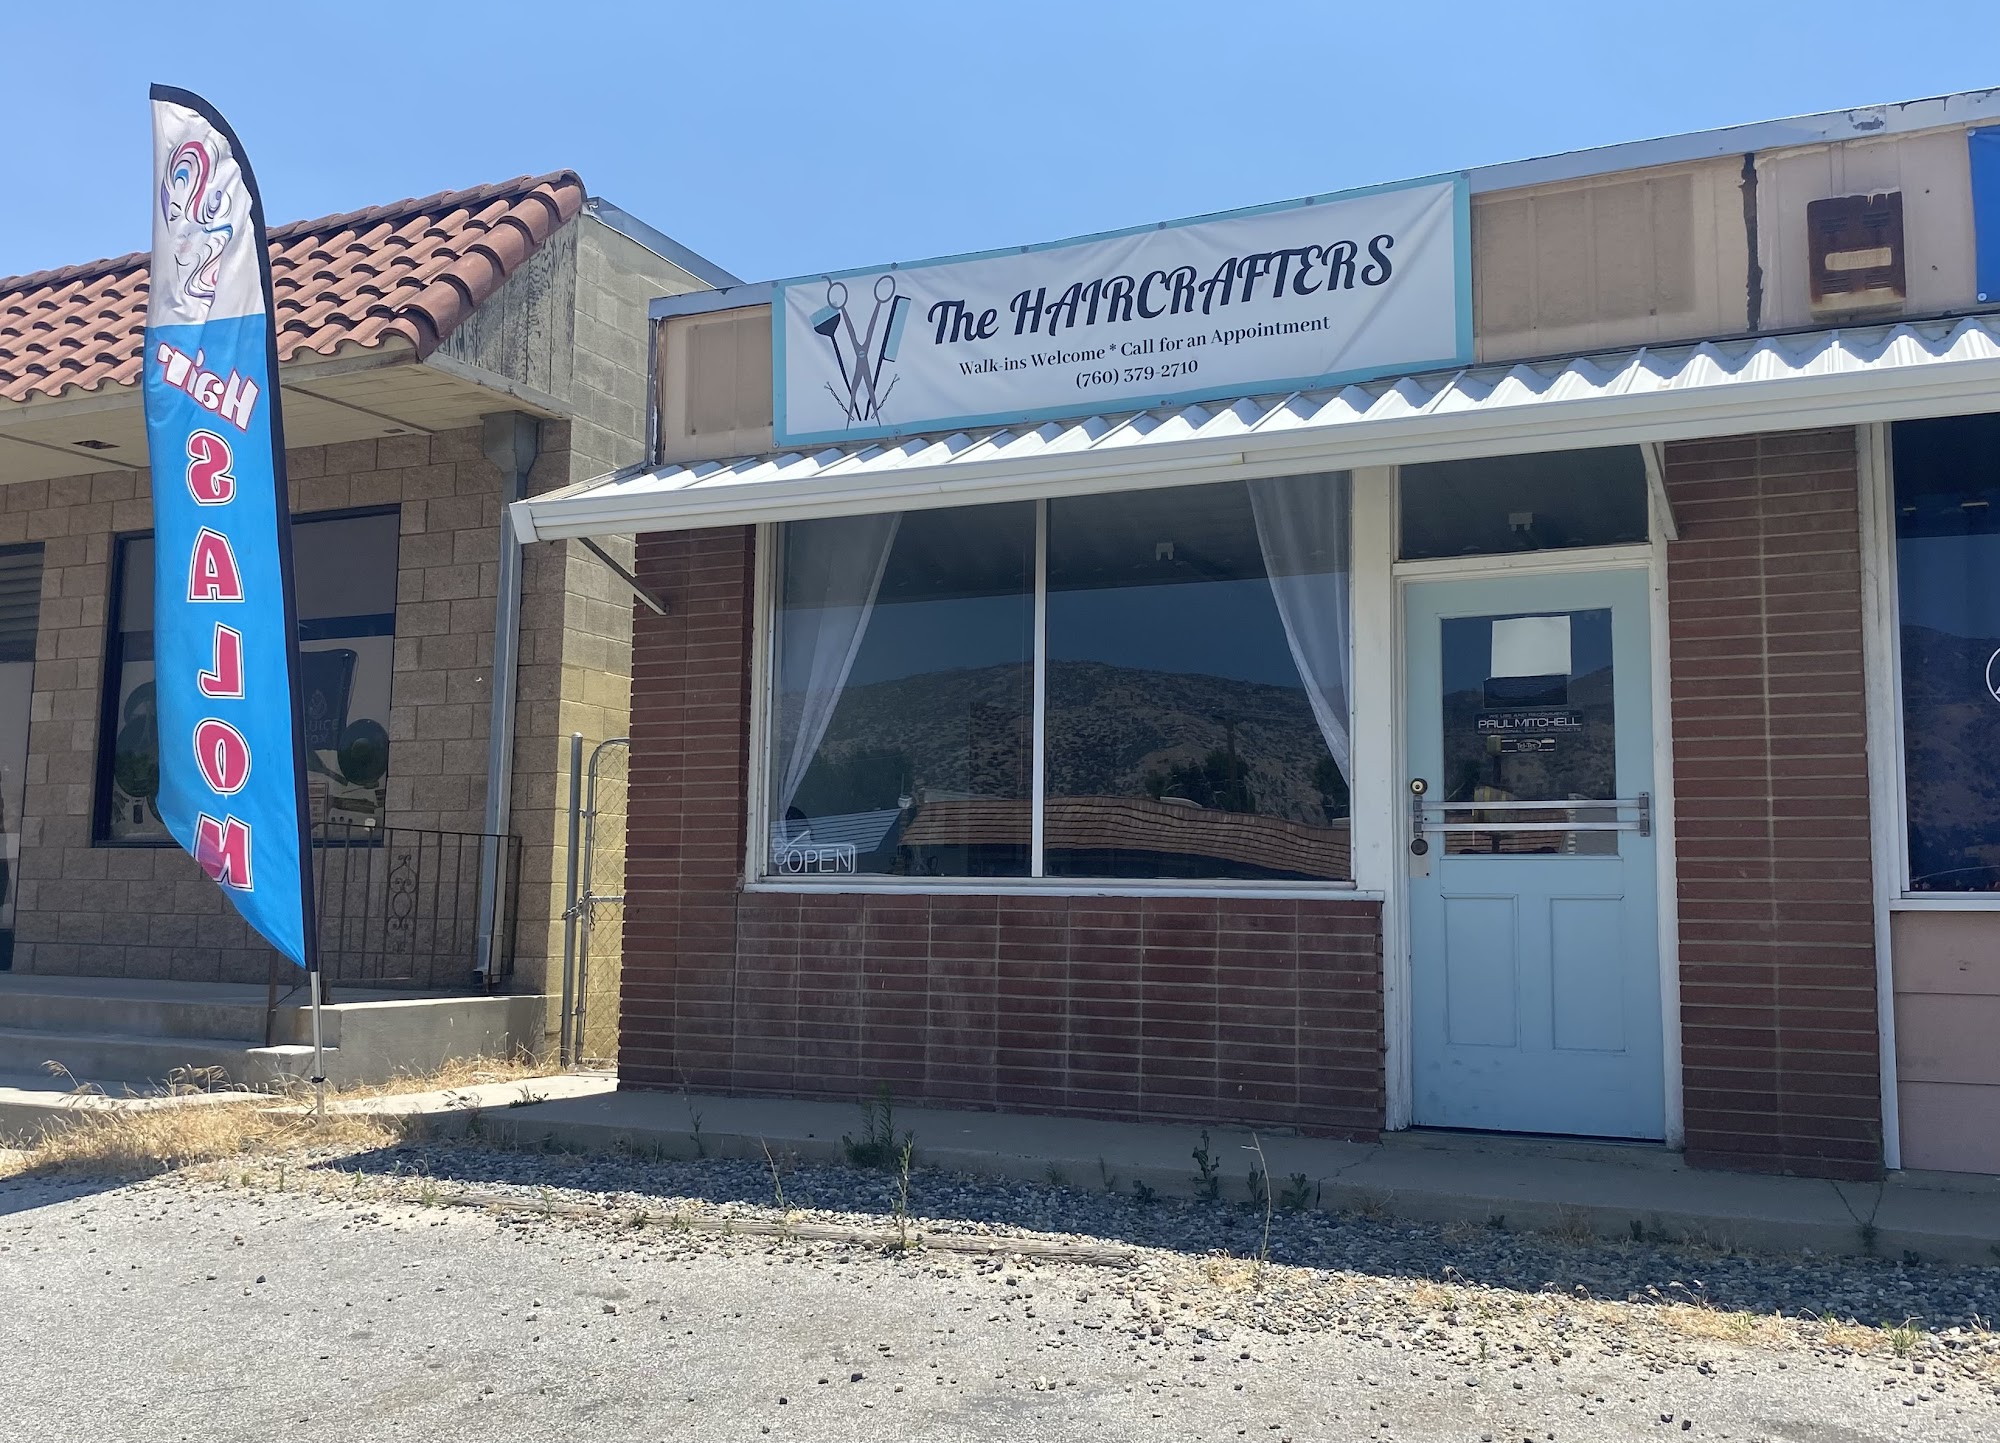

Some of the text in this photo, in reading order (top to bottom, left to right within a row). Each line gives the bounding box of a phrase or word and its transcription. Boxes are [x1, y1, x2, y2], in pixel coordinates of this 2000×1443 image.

[927, 234, 1394, 345] The HAIRCRAFTERS
[959, 358, 1027, 376] Walk-ins
[1030, 349, 1106, 367] Welcome
[1120, 339, 1154, 356] Call
[1159, 337, 1184, 352] for
[1187, 335, 1206, 347] an
[1211, 316, 1331, 345] Appointment
[1076, 360, 1199, 389] (760) 379-2710
[1478, 717, 1583, 729] PAUL MITCHELL
[787, 849, 852, 873] OPEN
